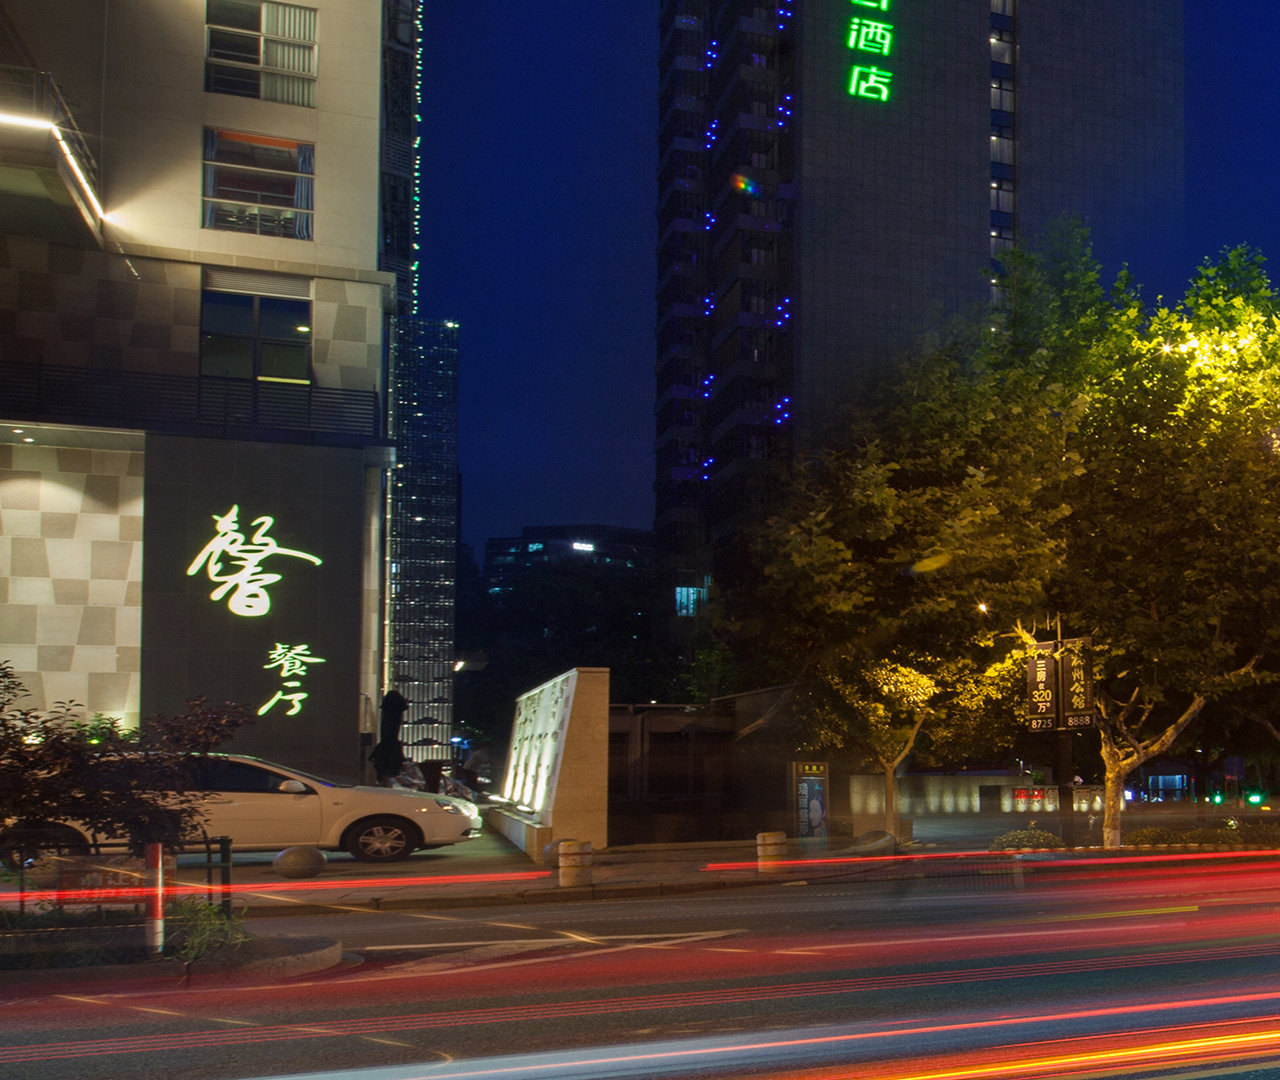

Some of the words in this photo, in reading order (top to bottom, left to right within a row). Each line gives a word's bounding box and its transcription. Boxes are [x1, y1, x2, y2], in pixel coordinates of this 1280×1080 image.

[186, 504, 323, 617] 馨
[257, 642, 327, 716] 餐厅
[1032, 689, 1052, 702] 320
[1031, 719, 1053, 729] 8725
[1067, 715, 1090, 726] 8888
